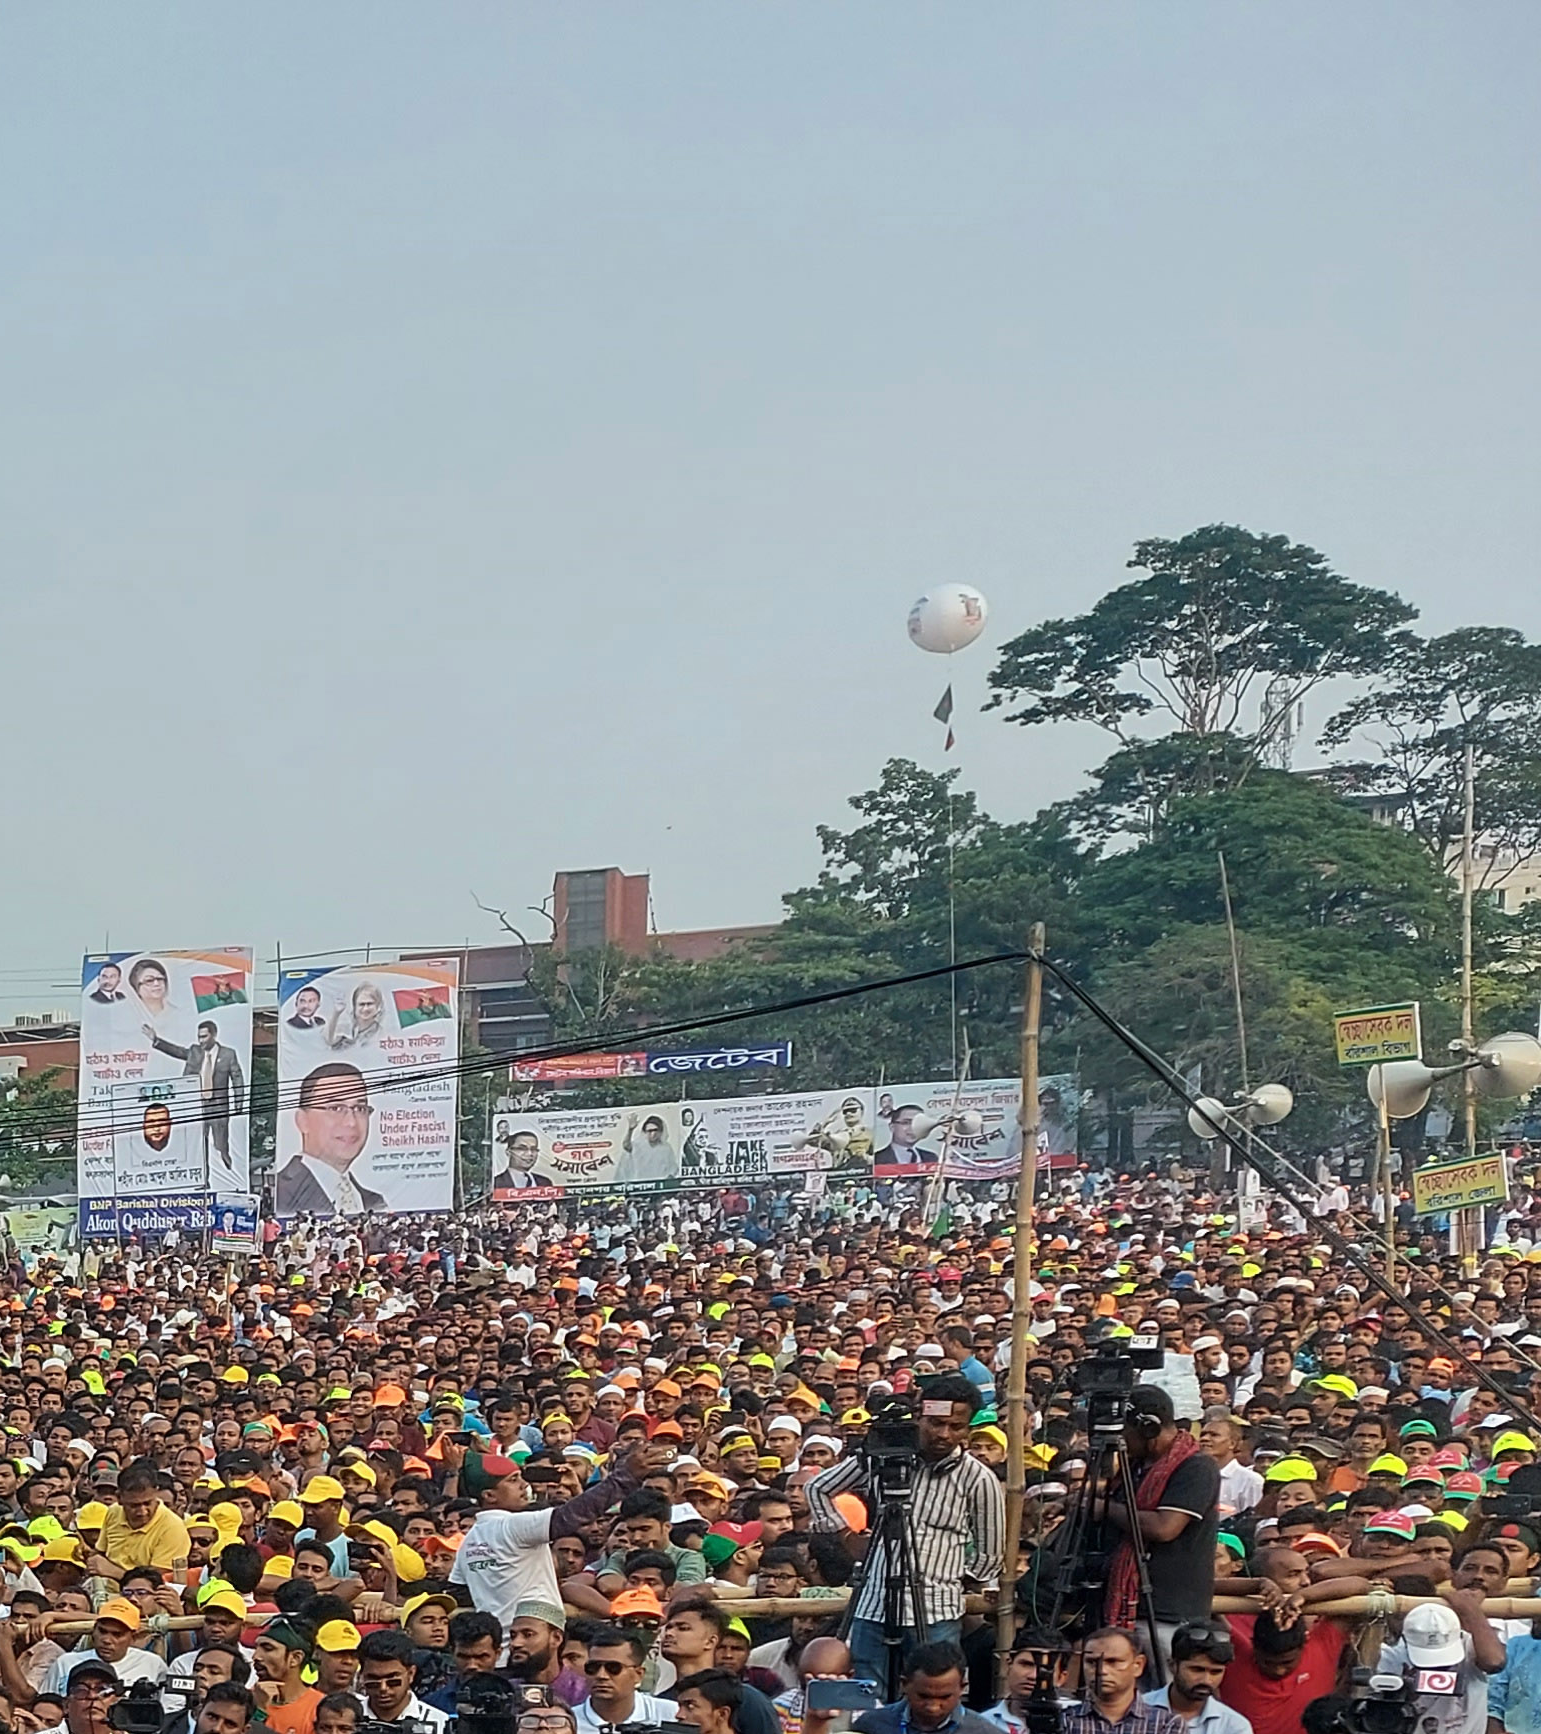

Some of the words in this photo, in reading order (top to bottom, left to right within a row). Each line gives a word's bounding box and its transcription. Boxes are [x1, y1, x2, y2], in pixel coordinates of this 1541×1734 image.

[1338, 1016, 1393, 1043] স্বেচ্ছাসেবক
[1396, 1013, 1414, 1033] দল
[1344, 1045, 1379, 1060] বরিশাল
[1382, 1039, 1412, 1056] বিভাগ
[380, 1111, 394, 1122] No
[396, 1108, 435, 1121] Election
[379, 1123, 410, 1135] Under
[411, 1121, 446, 1133] Fascist
[382, 1134, 415, 1147] Sheikh
[417, 1132, 451, 1146] Hasina
[728, 1139, 765, 1153] TAKE
[570, 1150, 594, 1161] গণ
[550, 1153, 615, 1176] সমাবেশ
[681, 1162, 768, 1176] BANGLADESH
[1417, 1165, 1478, 1193] স্বেচ্ছাসেবক
[1481, 1161, 1500, 1181] দল
[90, 1200, 113, 1210] BNP
[116, 1197, 159, 1210] Barishal
[1424, 1191, 1463, 1208] বরিশাল
[1468, 1186, 1496, 1200] জেলা
